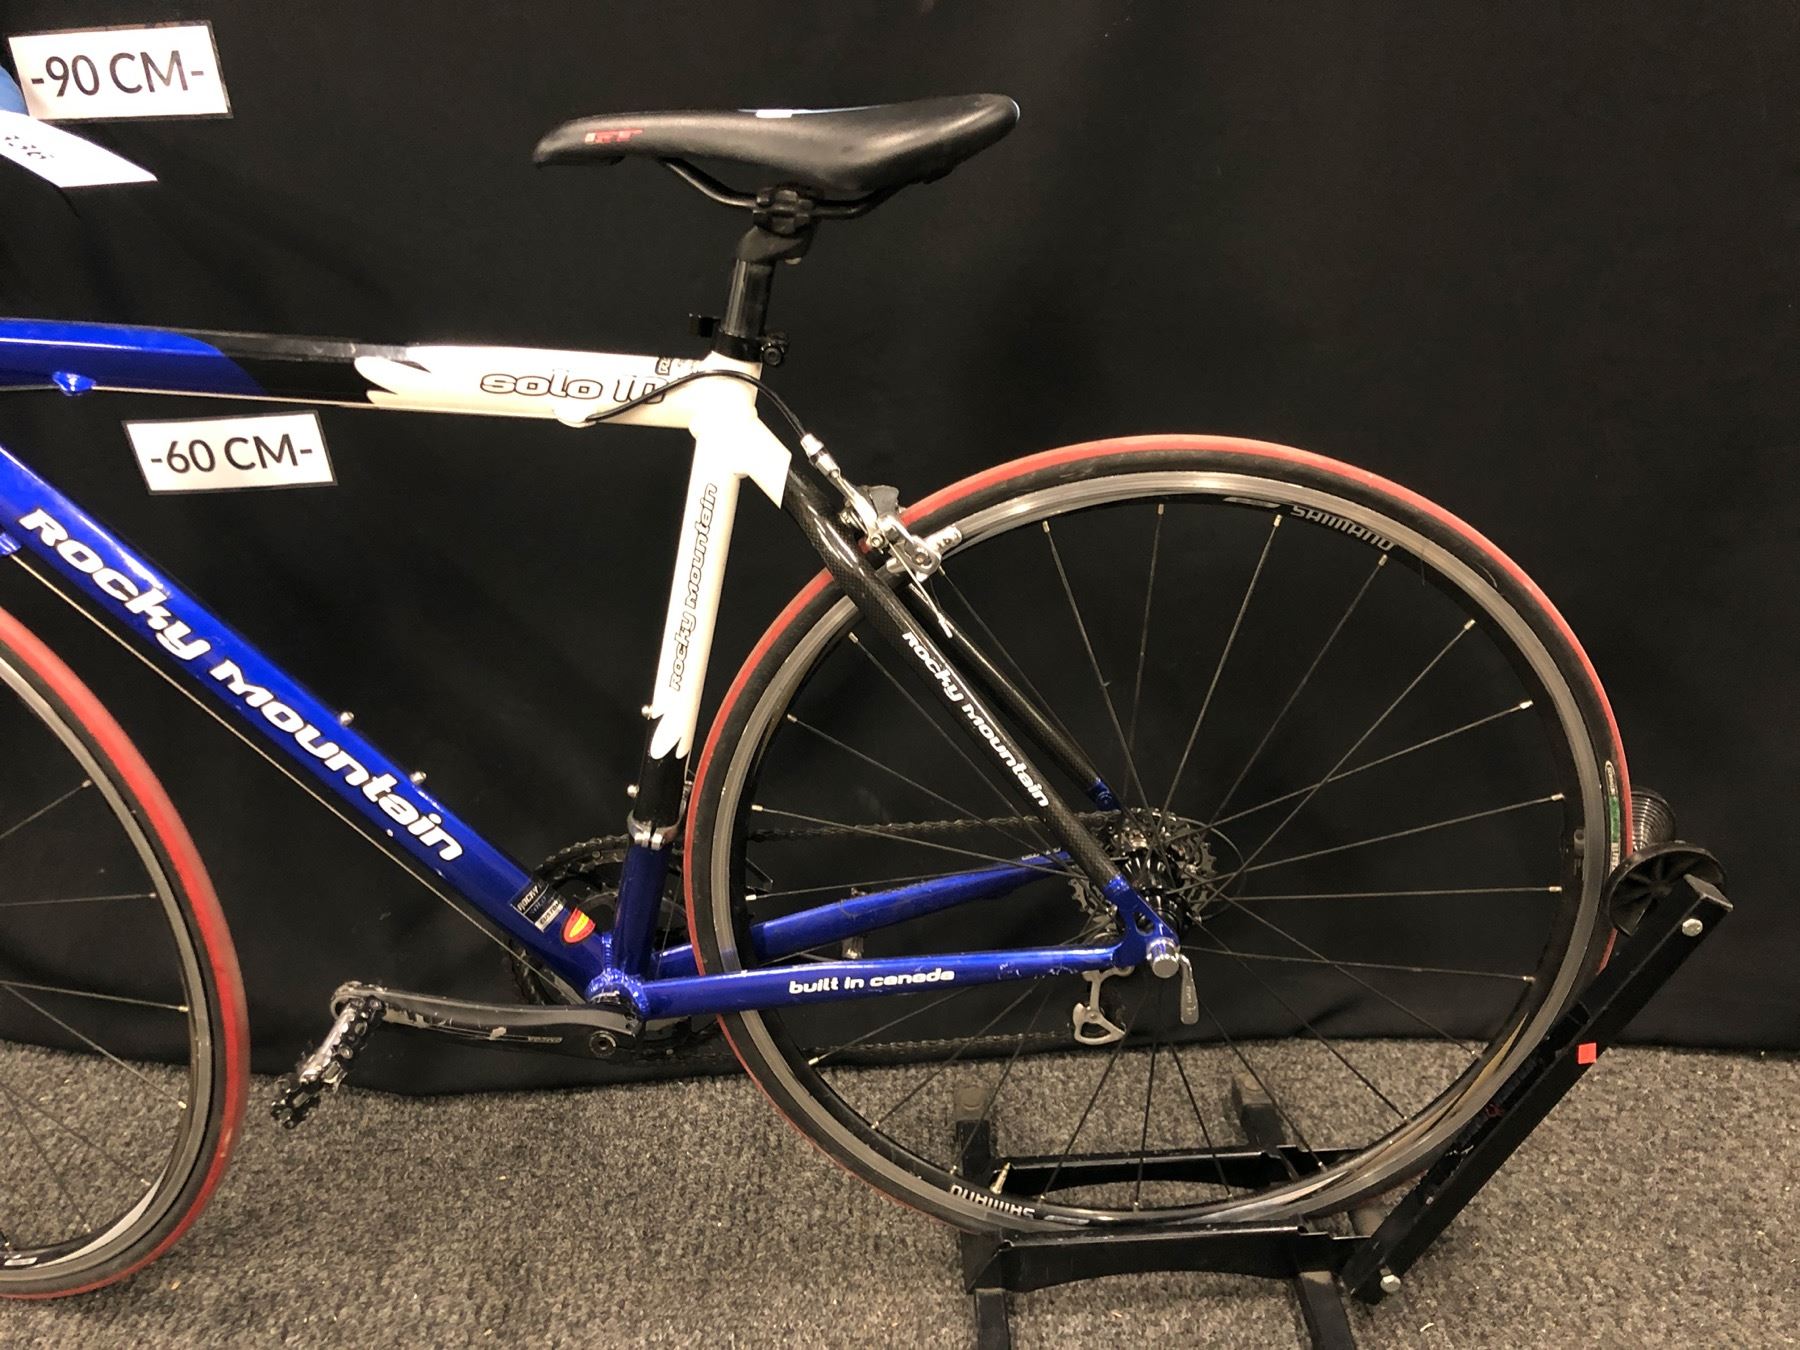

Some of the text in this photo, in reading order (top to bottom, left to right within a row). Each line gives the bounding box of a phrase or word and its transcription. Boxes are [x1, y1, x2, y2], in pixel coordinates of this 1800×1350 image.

[31, 49, 205, 98] -90 CM-
[150, 433, 313, 474] -60 CM-
[1290, 505, 1396, 552] SHIMANO
[669, 482, 718, 692] Rocky Mountain
[18, 507, 464, 862] Rocky Mountain
[961, 703, 1049, 808] Mountain
[788, 976, 839, 995] built
[844, 976, 865, 990] in
